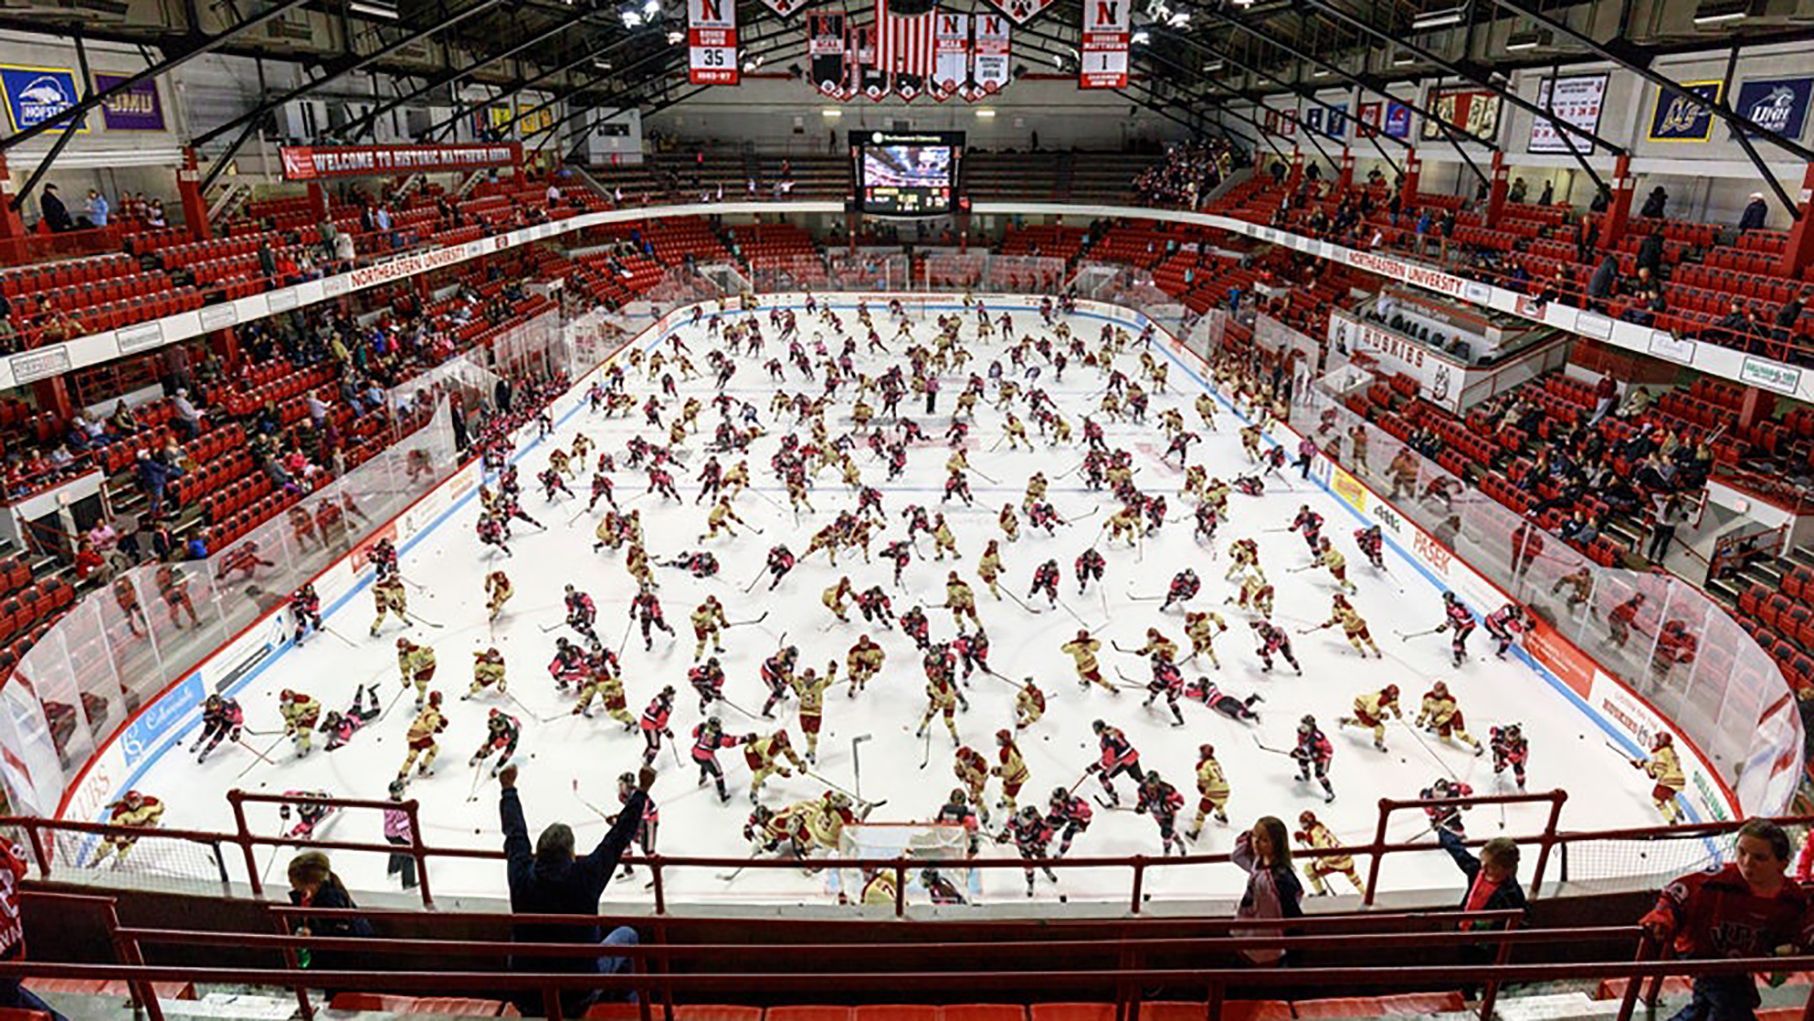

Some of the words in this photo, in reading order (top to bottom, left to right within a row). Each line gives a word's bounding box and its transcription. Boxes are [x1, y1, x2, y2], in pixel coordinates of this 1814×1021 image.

[943, 16, 959, 33] N
[1097, 1, 1118, 25] N
[985, 16, 1000, 34] N
[704, 49, 724, 66] 35
[312, 151, 374, 171] WELCOME
[376, 151, 392, 168] TO
[394, 150, 438, 167] HISTORIC
[441, 149, 487, 164] MATTHEWS
[351, 259, 422, 288] NORTHEASTERN
[423, 247, 466, 268] UNIVERSITY
[1349, 252, 1406, 277] NORTHEASTERN
[1408, 265, 1464, 294] UNIVERSITY
[1363, 327, 1424, 368] HUSKIES
